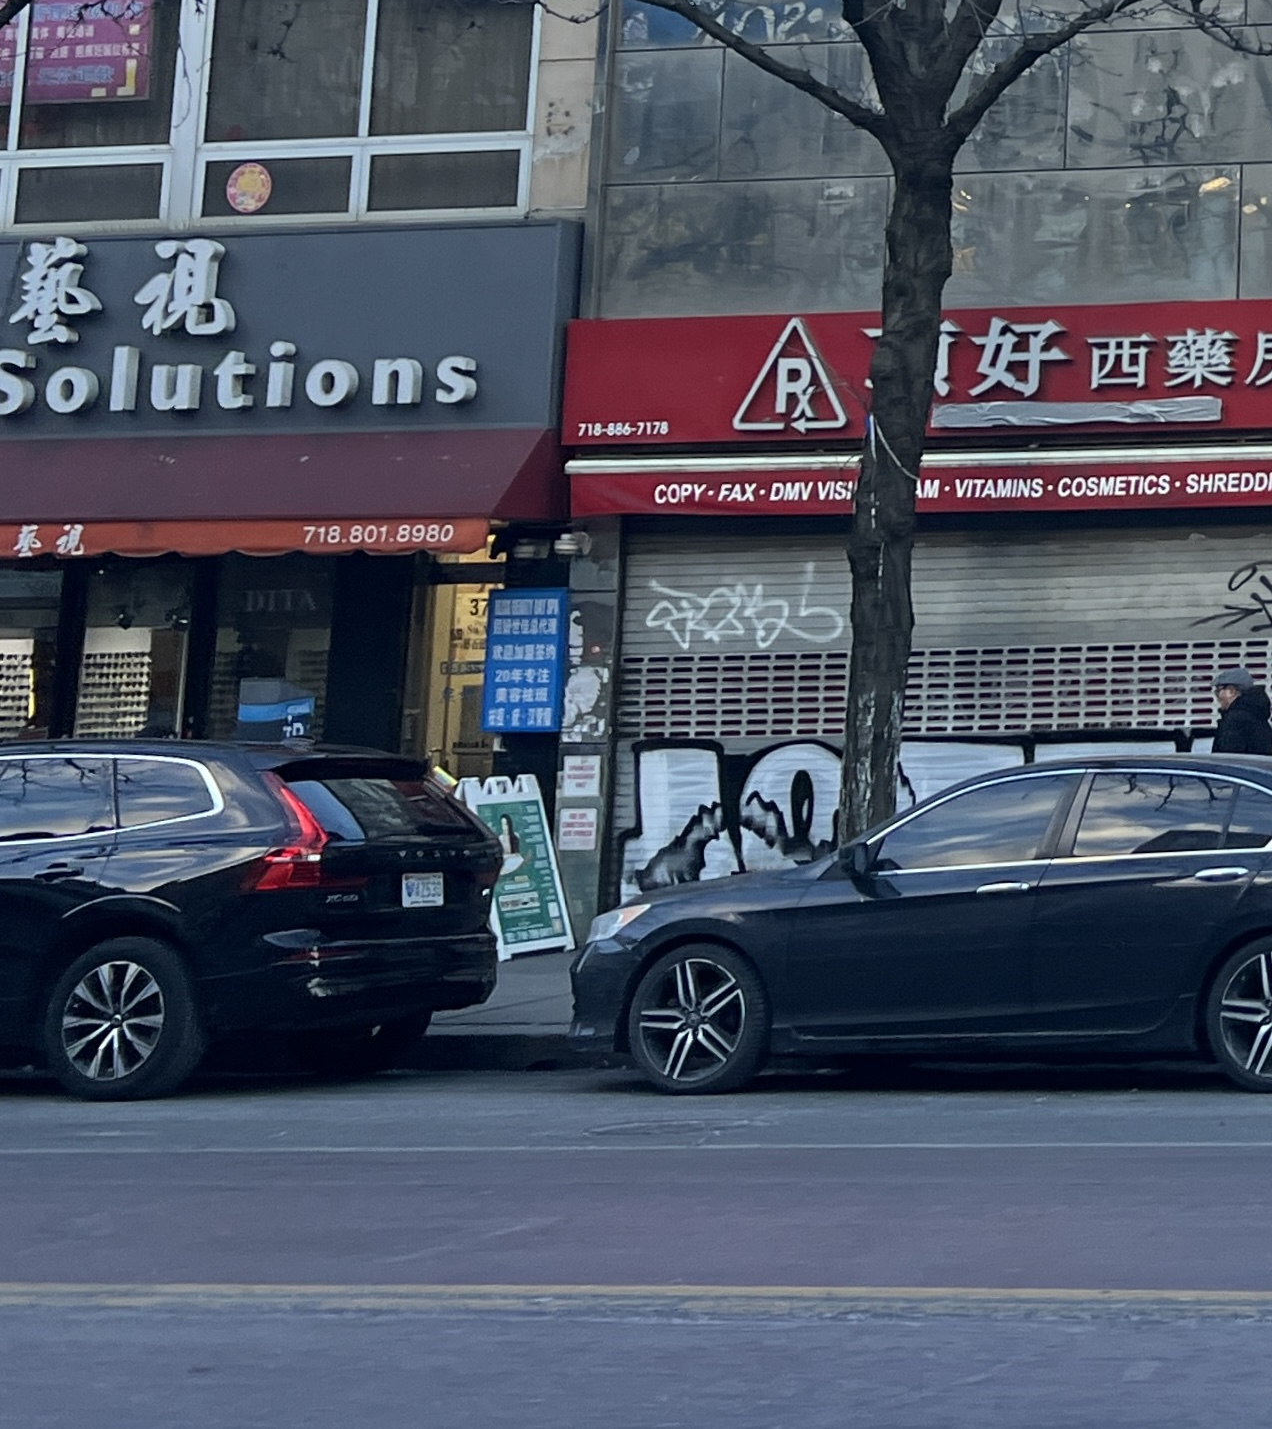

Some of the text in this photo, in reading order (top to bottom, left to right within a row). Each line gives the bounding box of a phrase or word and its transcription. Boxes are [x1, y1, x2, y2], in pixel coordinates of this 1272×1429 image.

[10, 237, 236, 345] 藝視
[0, 341, 478, 416] Solutions
[577, 420, 669, 437] 718-886-7178
[654, 483, 704, 503] COPY
[717, 482, 757, 502] FAX
[769, 481, 812, 501] DMV
[955, 476, 1044, 499] VITAMINS
[1057, 473, 1171, 497] COSMETICS
[303, 523, 455, 545] 718.801.8980
